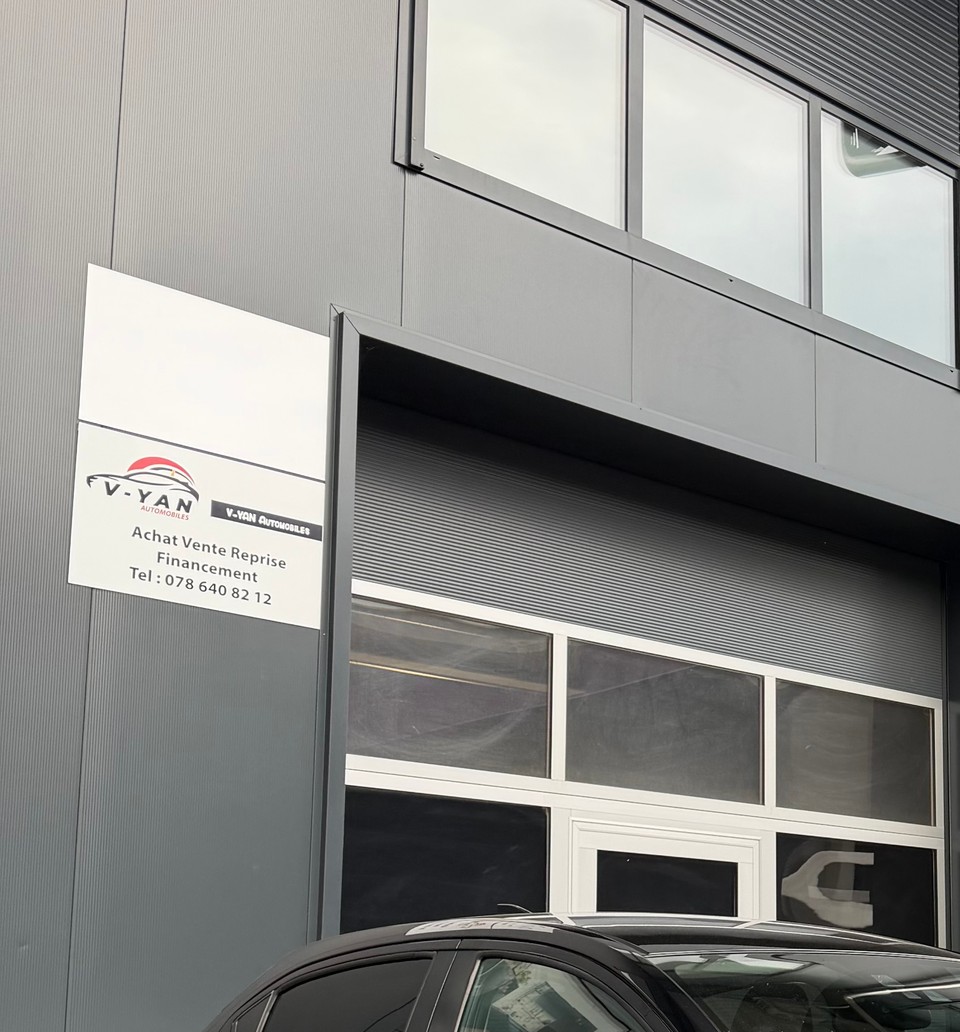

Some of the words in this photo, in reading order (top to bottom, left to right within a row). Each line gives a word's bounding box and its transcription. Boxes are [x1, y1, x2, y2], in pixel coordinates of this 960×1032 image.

[104, 480, 193, 514] V-YAN
[140, 505, 190, 521] AUTOMOBILES
[226, 507, 257, 524] V-YAN
[131, 526, 179, 547] Achat
[182, 536, 227, 557] Vente
[231, 546, 287, 570] Reprise
[156, 551, 259, 584] Financement
[164, 573, 195, 591] 078
[198, 581, 228, 597] 640
[231, 586, 250, 602] 82
[254, 591, 273, 606] 12
